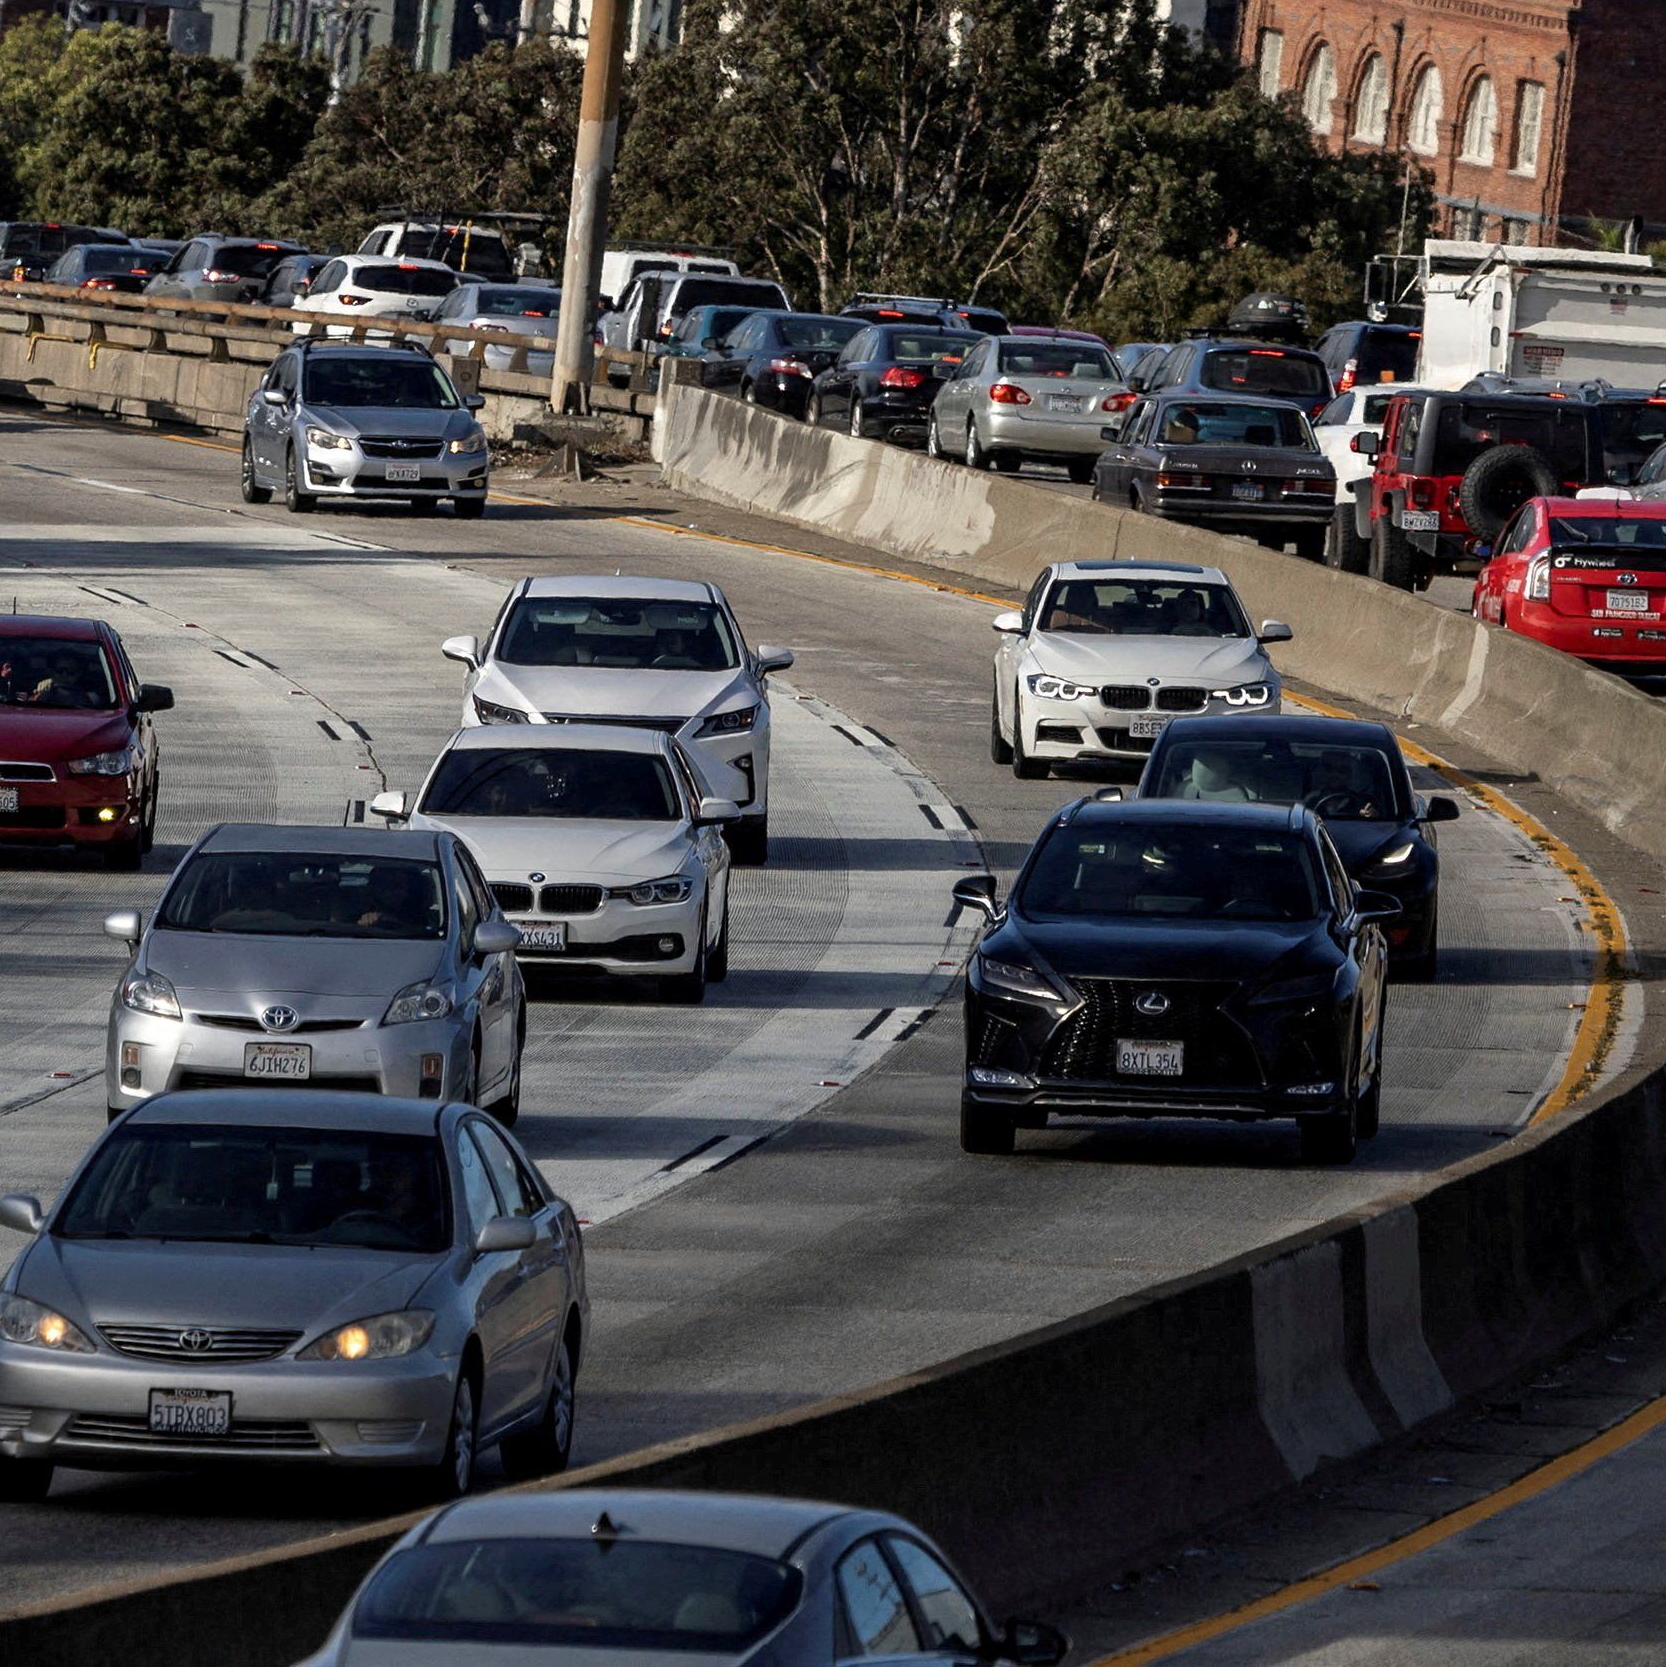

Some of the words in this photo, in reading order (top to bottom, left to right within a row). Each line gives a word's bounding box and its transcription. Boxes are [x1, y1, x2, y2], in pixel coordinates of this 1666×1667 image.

[520, 931, 560, 945] XXS431
[249, 1056, 306, 1074] 6JIH276
[1122, 1052, 1178, 1070] 8XTL354
[174, 1389, 207, 1397] TOYOTA
[153, 1404, 226, 1426] 5TBX803
